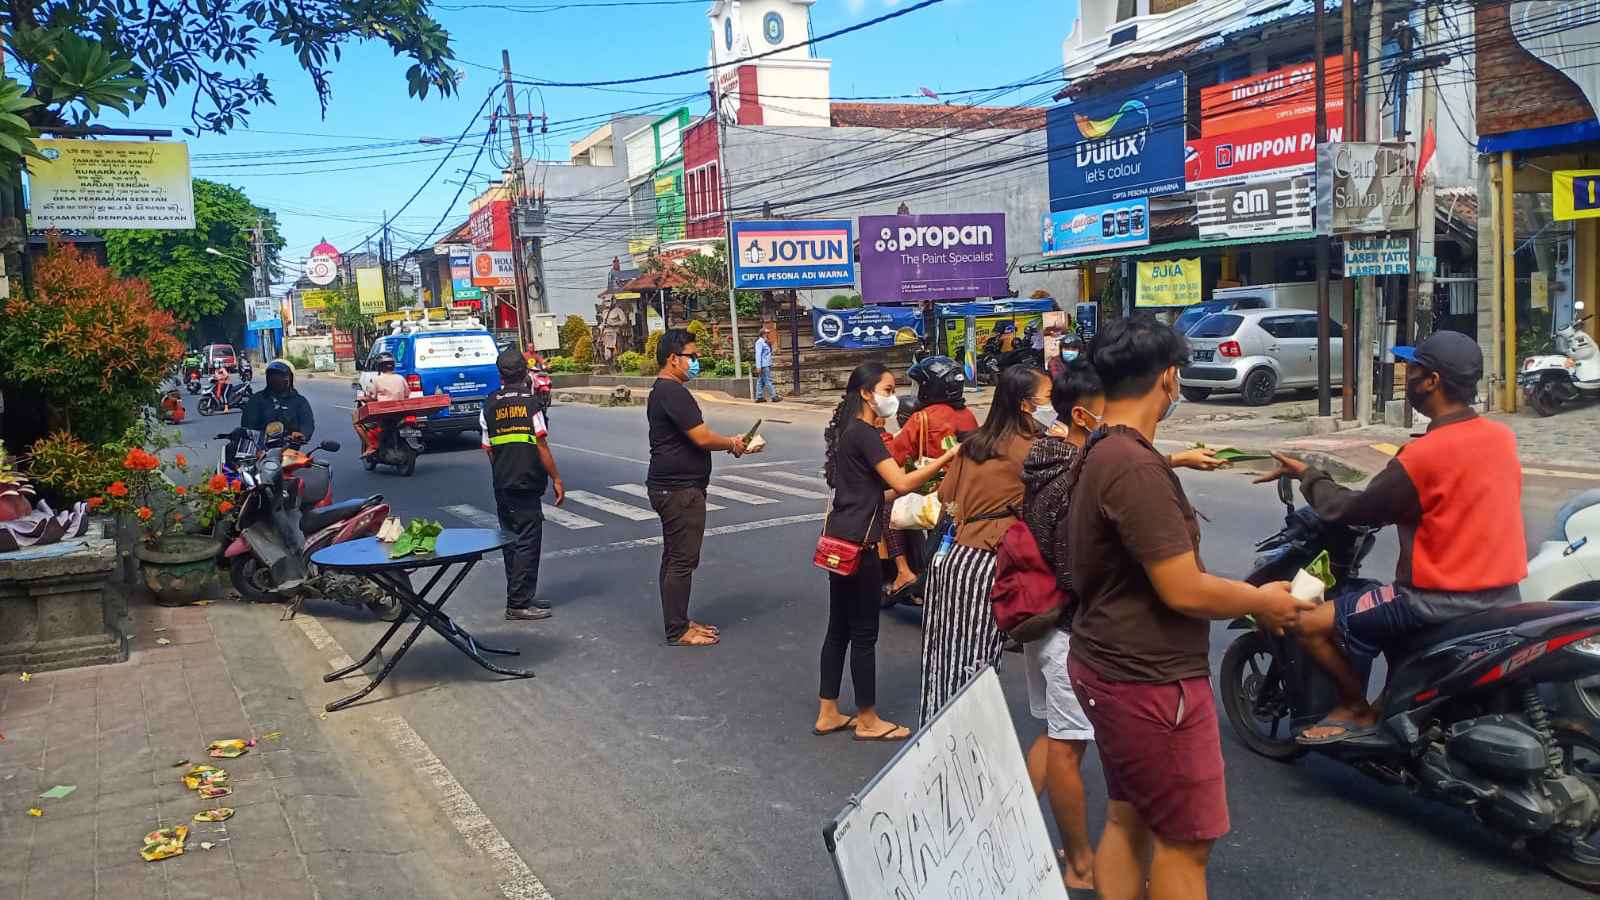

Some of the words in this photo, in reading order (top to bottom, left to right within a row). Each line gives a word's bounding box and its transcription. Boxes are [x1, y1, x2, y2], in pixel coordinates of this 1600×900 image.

[1075, 134, 1139, 168] Dulux
[1235, 136, 1297, 162] NIPPON
[1085, 169, 1105, 184] let's
[1107, 163, 1141, 179] colour
[1232, 188, 1269, 215] am
[1335, 186, 1377, 209] Salon
[898, 225, 993, 251] propan
[769, 239, 843, 262] JOTUN
[901, 254, 919, 265] The
[922, 253, 947, 264] Paint
[948, 252, 993, 265] Specialist
[742, 272, 765, 281] CIPTA
[767, 271, 800, 280] PESONA
[802, 271, 817, 279] ADI
[818, 270, 849, 279] WARNA
